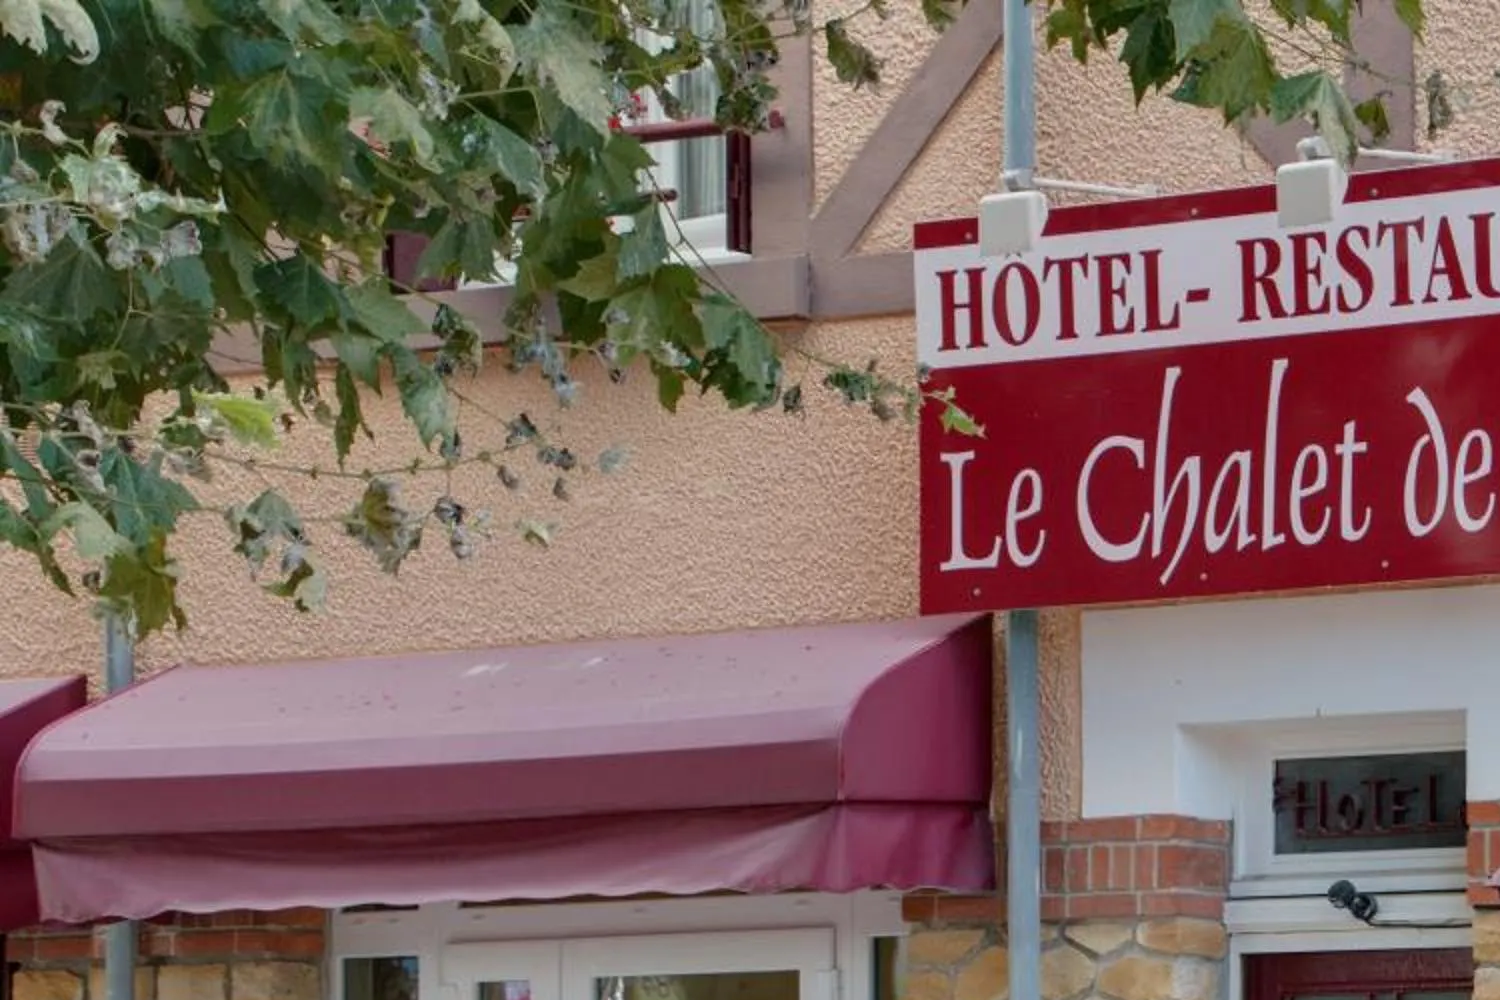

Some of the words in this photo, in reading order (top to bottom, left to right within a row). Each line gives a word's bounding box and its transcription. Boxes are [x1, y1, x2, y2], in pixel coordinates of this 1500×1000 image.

[939, 450, 1046, 572] Le
[1077, 358, 1373, 587] Chalet
[1404, 386, 1497, 538] de
